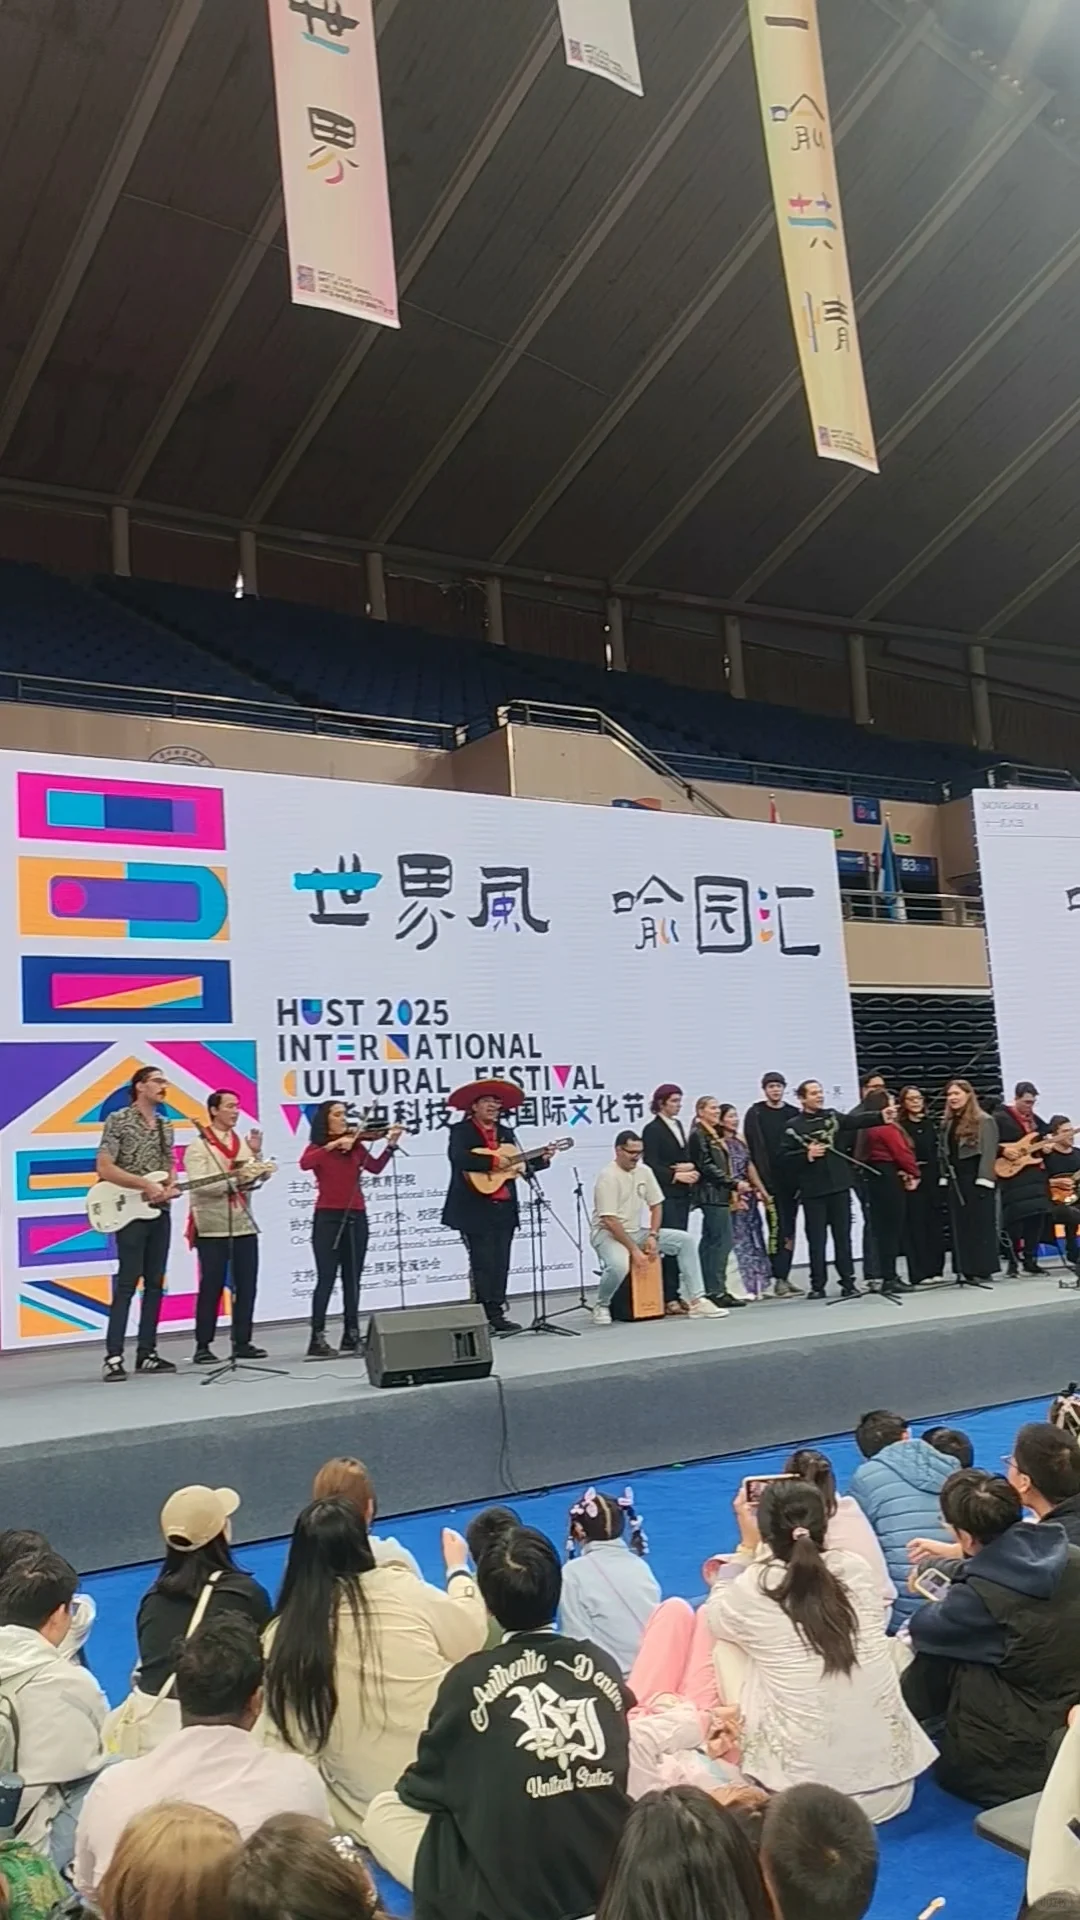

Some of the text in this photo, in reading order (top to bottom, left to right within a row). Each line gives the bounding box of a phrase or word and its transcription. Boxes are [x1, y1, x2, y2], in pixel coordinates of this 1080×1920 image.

[612, 874, 821, 956] 喻园汇
[277, 998, 449, 1026] HUST 2025
[278, 1033, 542, 1062] INTERNATIONAL
[283, 1067, 451, 1098] CULTURAL
[469, 1649, 548, 1733] Authentic
[526, 1765, 615, 1798] United States
